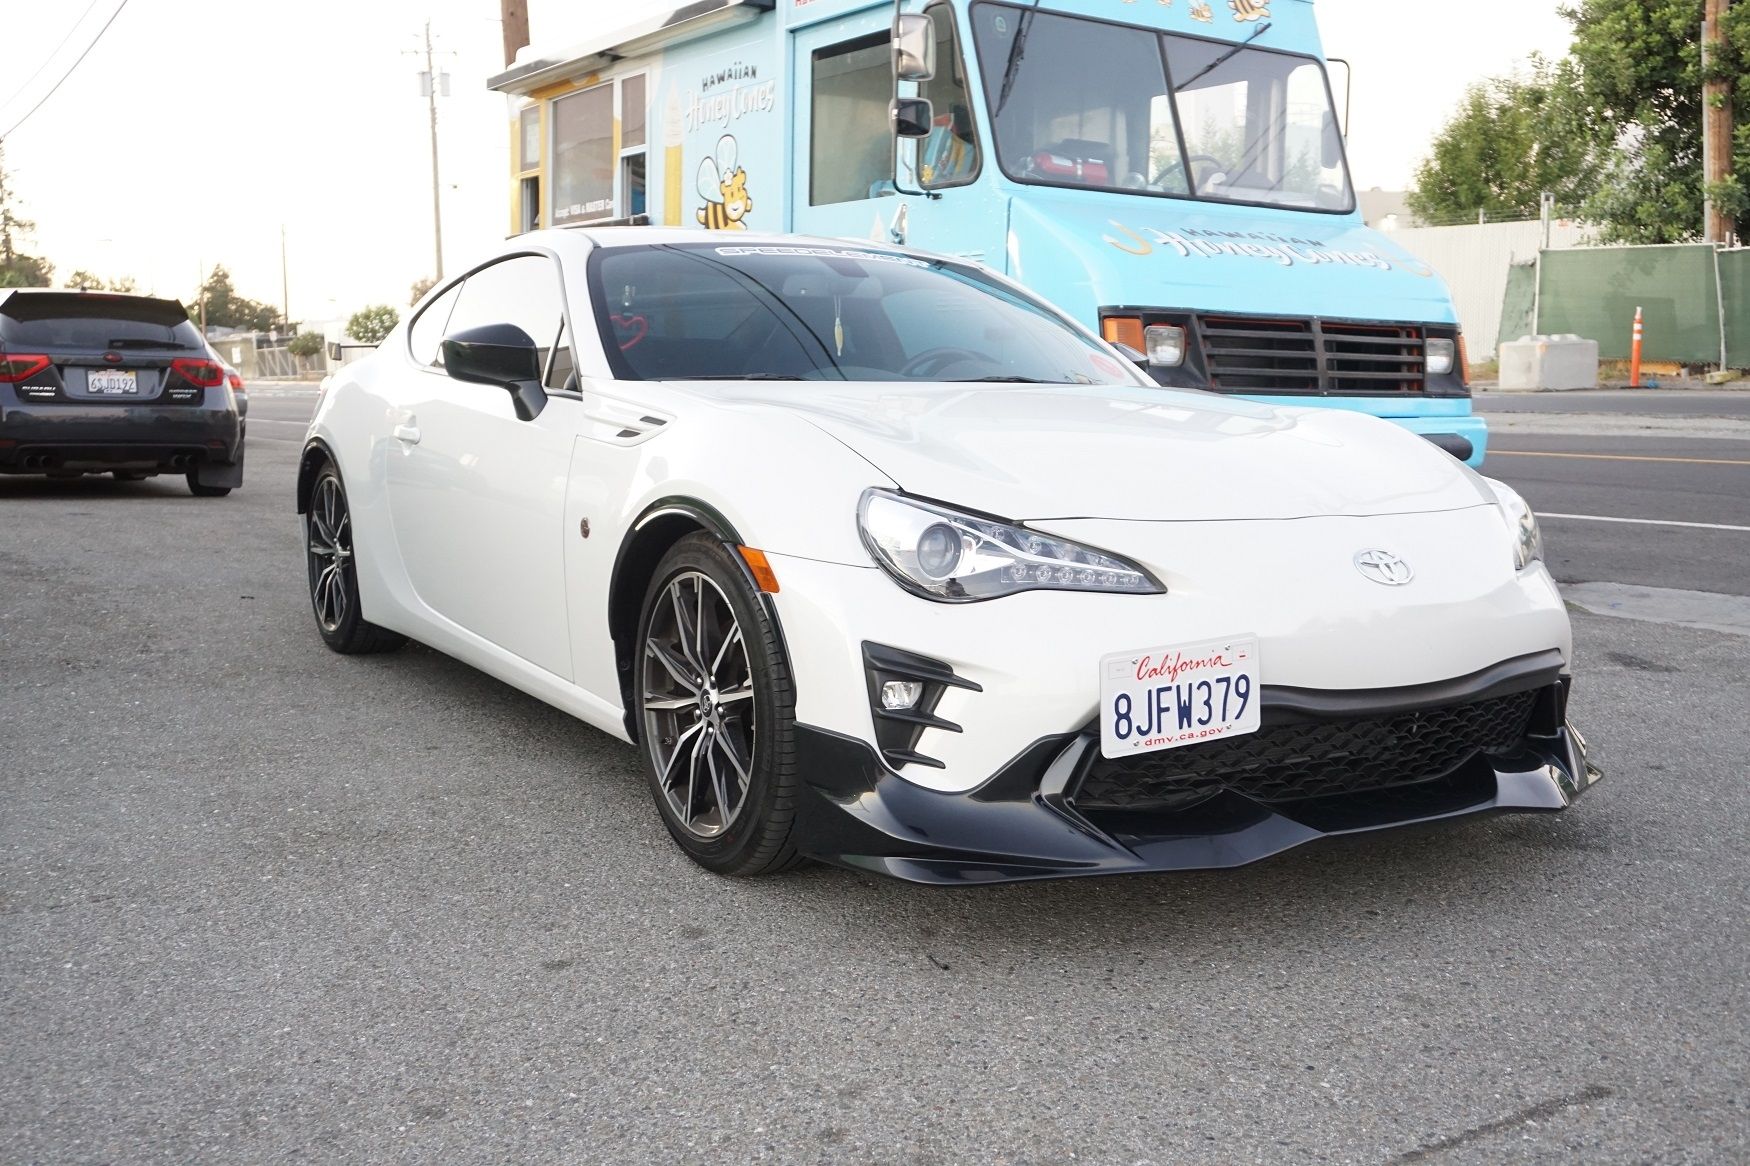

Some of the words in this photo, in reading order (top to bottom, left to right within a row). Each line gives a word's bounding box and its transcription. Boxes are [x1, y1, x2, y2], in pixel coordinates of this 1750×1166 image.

[1144, 228, 1293, 267] Honey
[1279, 242, 1393, 271] Cones
[1135, 651, 1233, 683] California
[1114, 674, 1251, 740] 8JFW379
[1143, 726, 1225, 748] dmv.ca.gov
